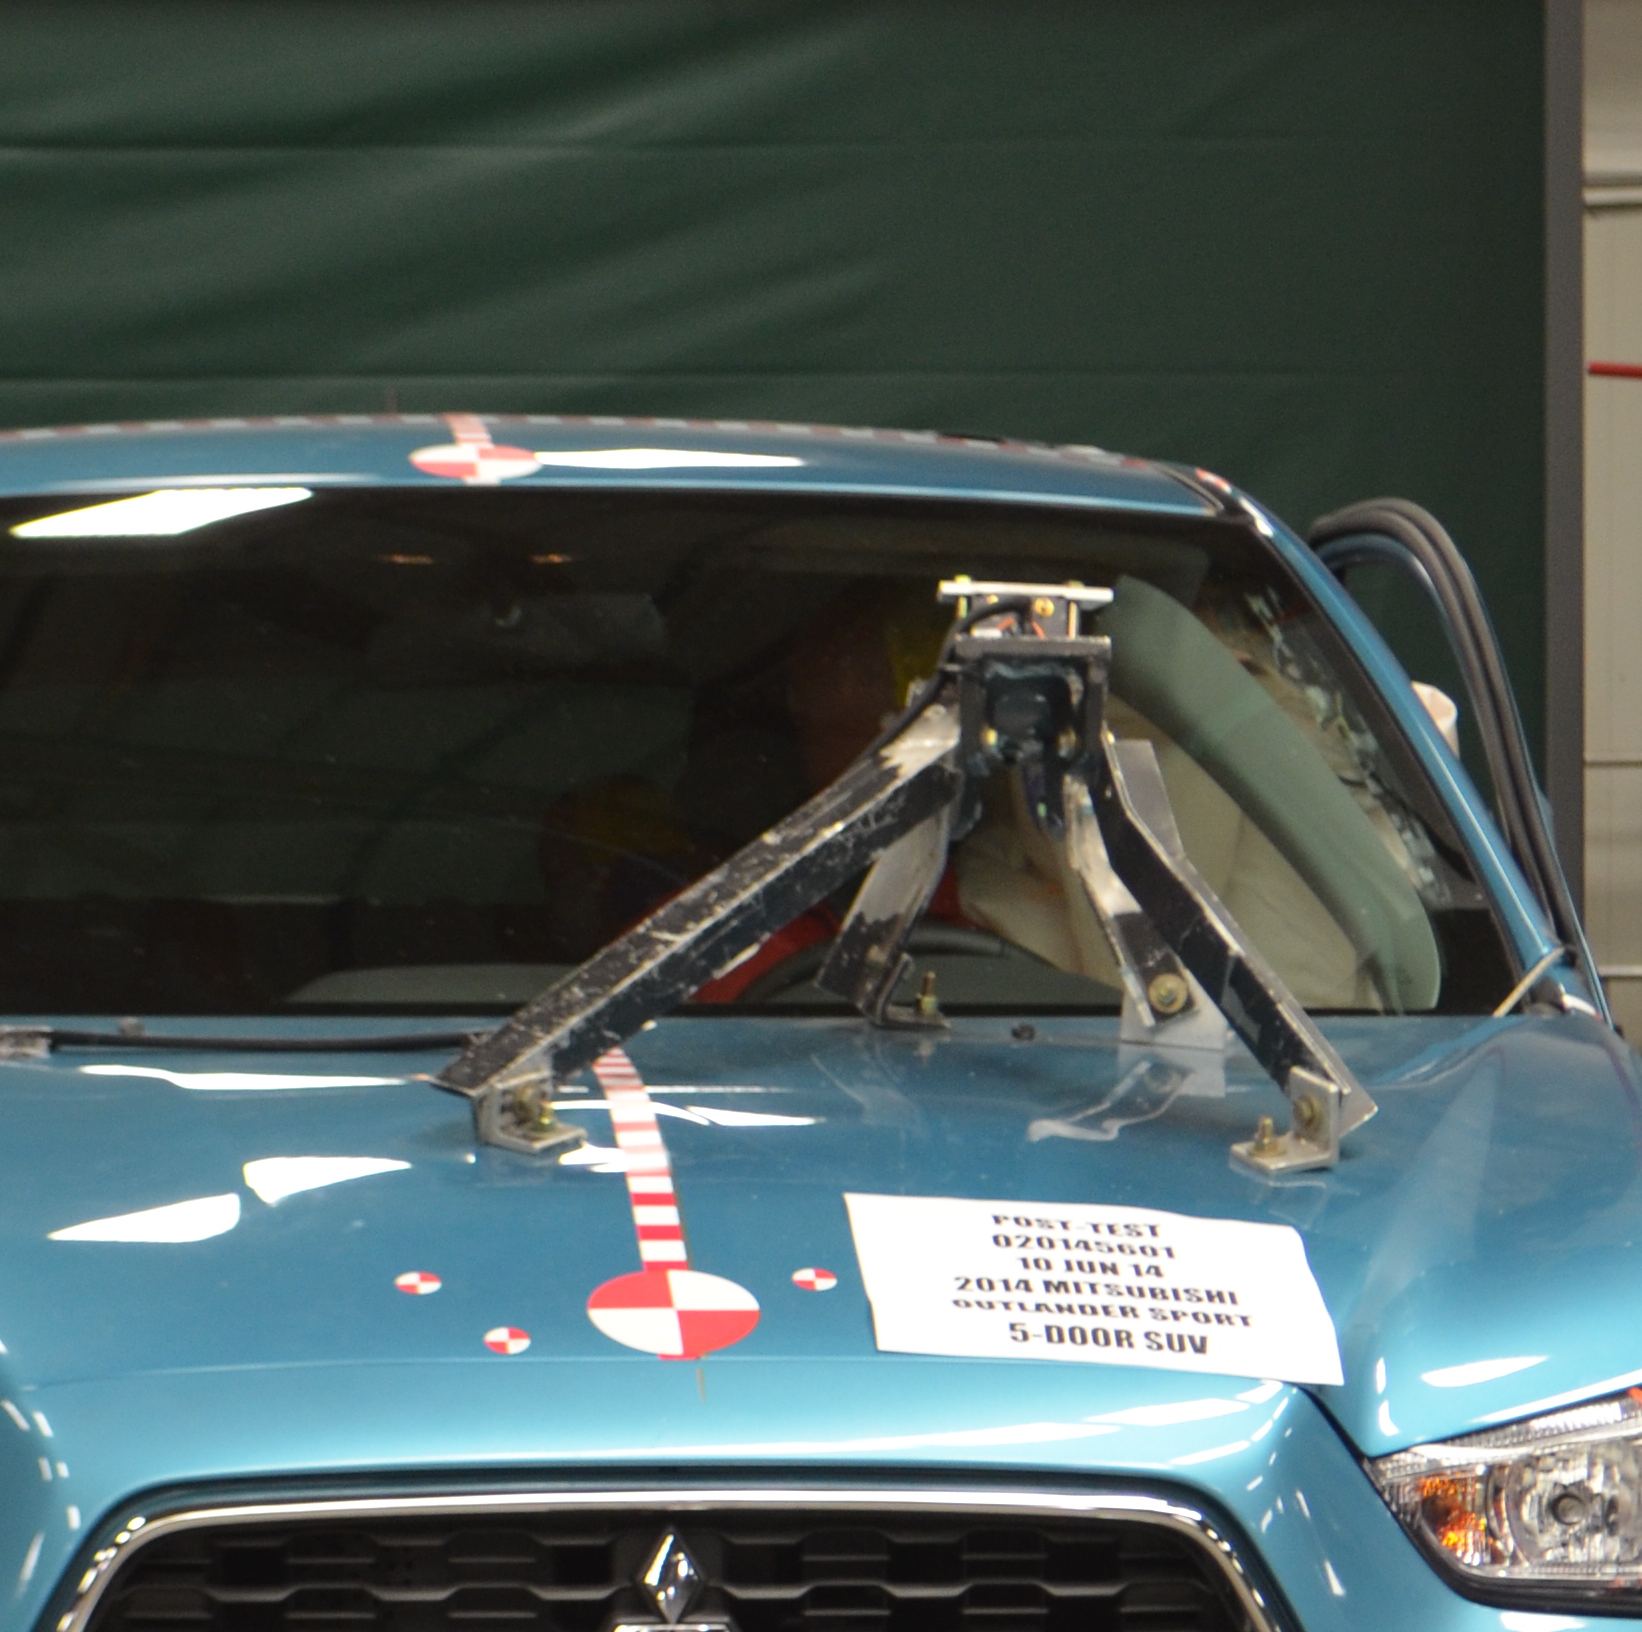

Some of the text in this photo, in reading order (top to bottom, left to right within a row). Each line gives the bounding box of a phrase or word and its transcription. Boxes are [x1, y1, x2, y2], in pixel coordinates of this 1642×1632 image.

[992, 1234, 1176, 1259] 020145601
[1016, 1257, 1163, 1278] 10 JUN 14
[954, 1276, 1239, 1305] 2014 MITSUBISHI
[951, 1299, 1252, 1327] OUTLANDER SPORT
[1008, 1322, 1208, 1354] 5-DOOR SUV
